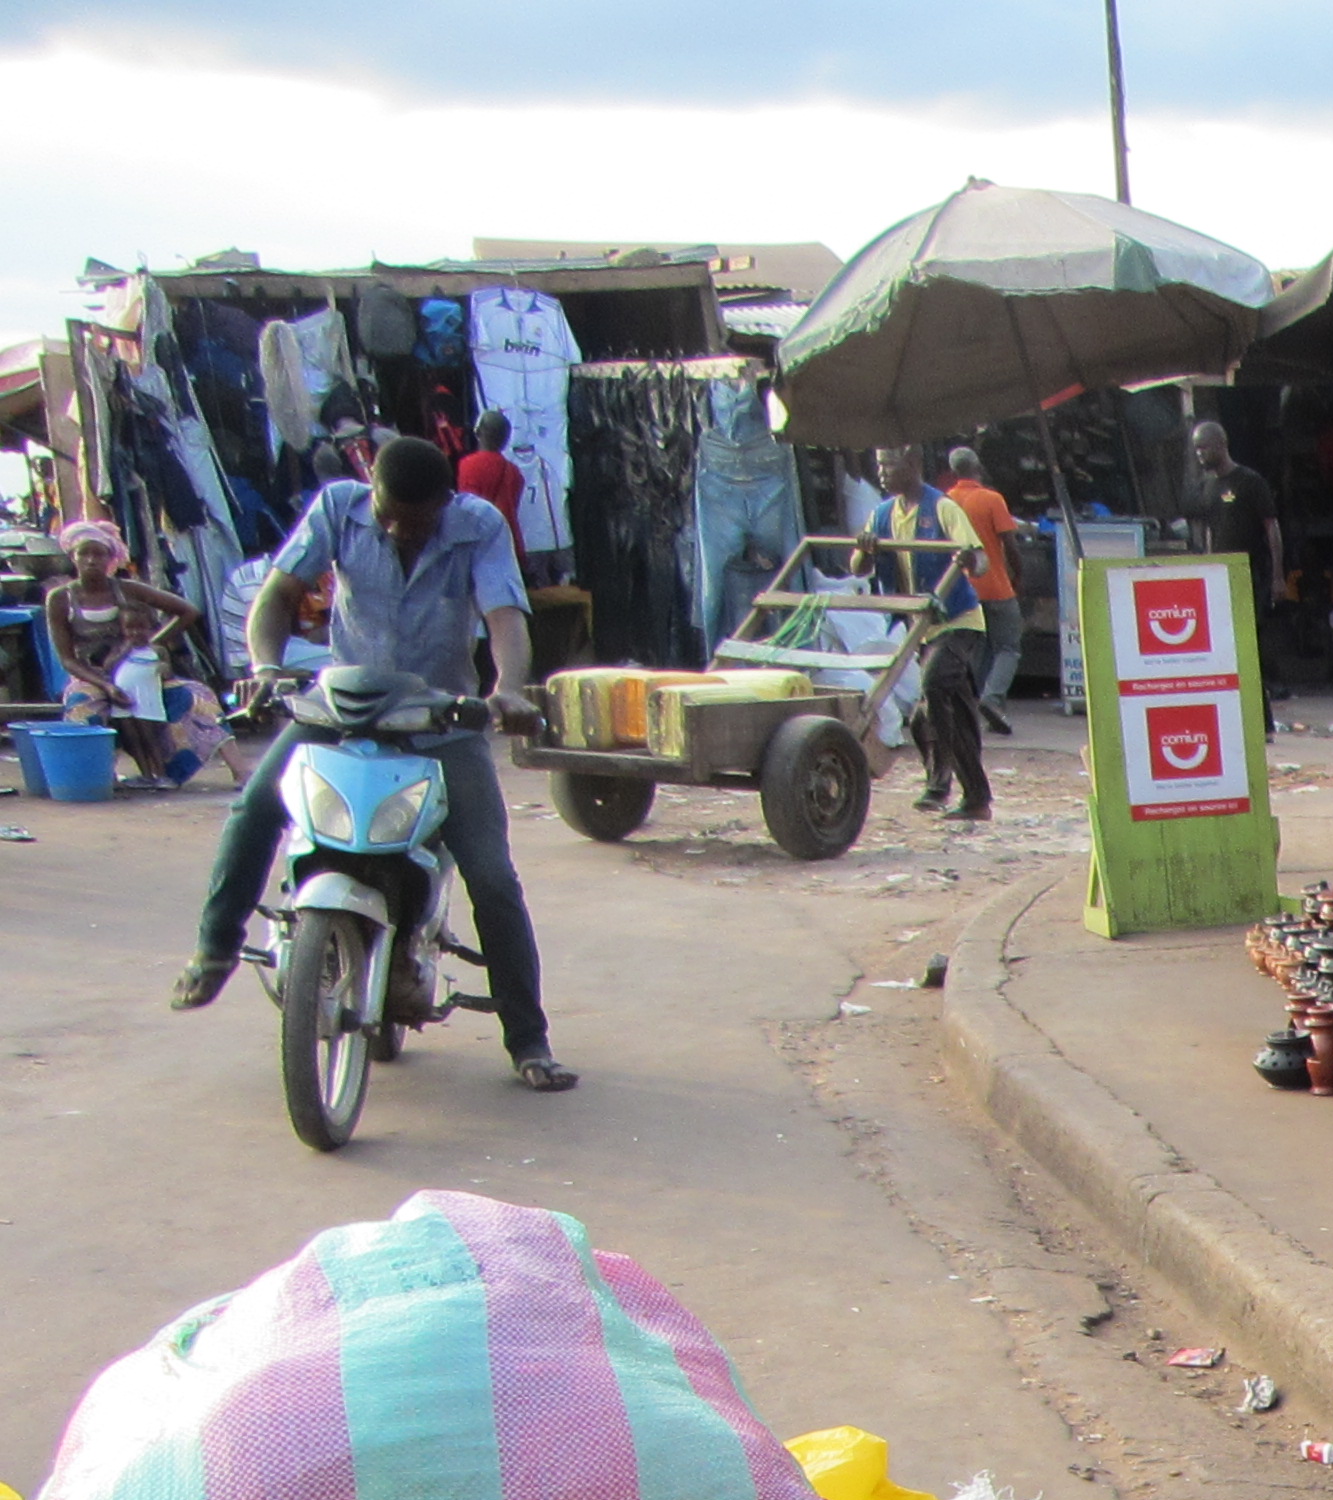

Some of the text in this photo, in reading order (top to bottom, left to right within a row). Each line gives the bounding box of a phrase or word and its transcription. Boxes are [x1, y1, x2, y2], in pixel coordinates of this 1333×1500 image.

[526, 484, 537, 505] 7
[1148, 604, 1197, 619] comium
[1161, 730, 1208, 745] comium
